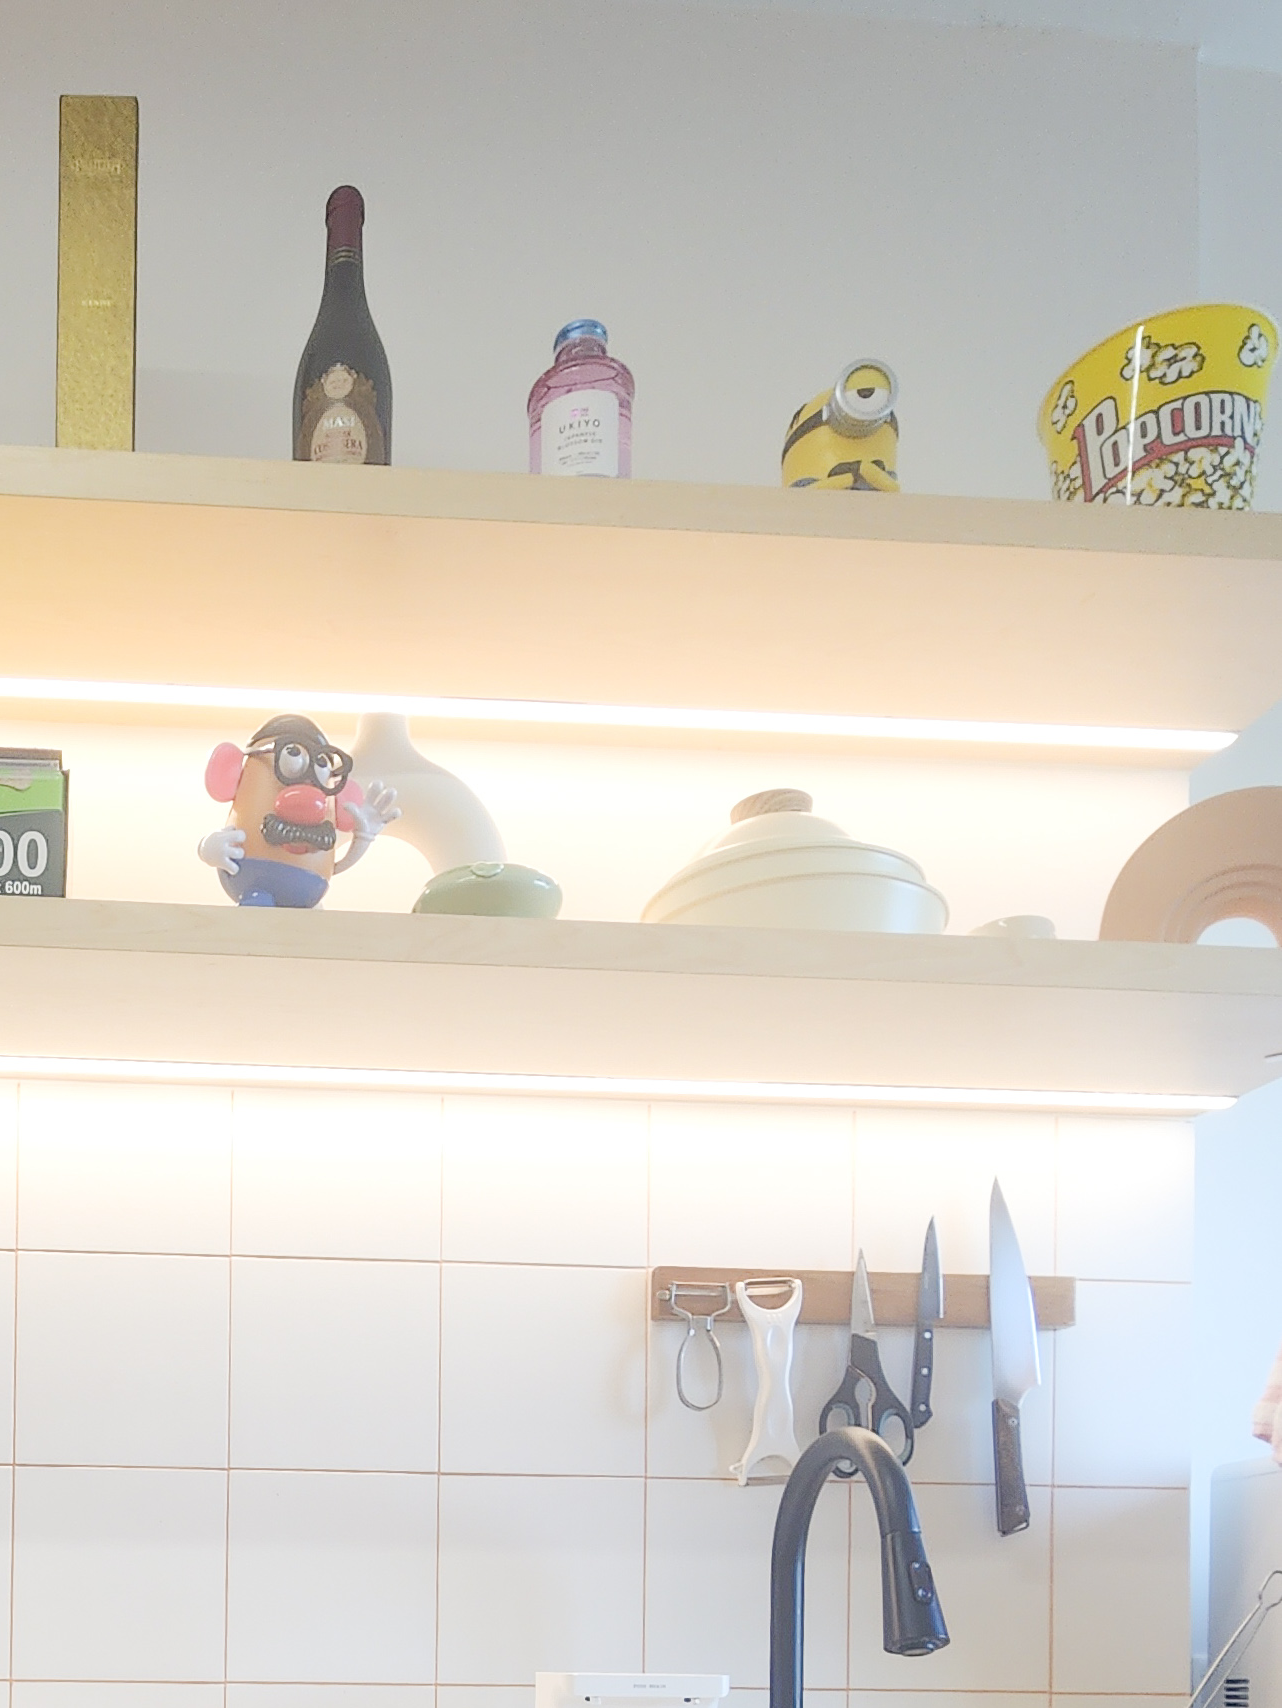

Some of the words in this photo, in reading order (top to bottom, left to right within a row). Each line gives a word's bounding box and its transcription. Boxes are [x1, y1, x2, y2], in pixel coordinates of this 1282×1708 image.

[559, 419, 600, 434] UKIYO
[1072, 391, 1264, 502] POPCORN
[5, 880, 42, 895] 600m
